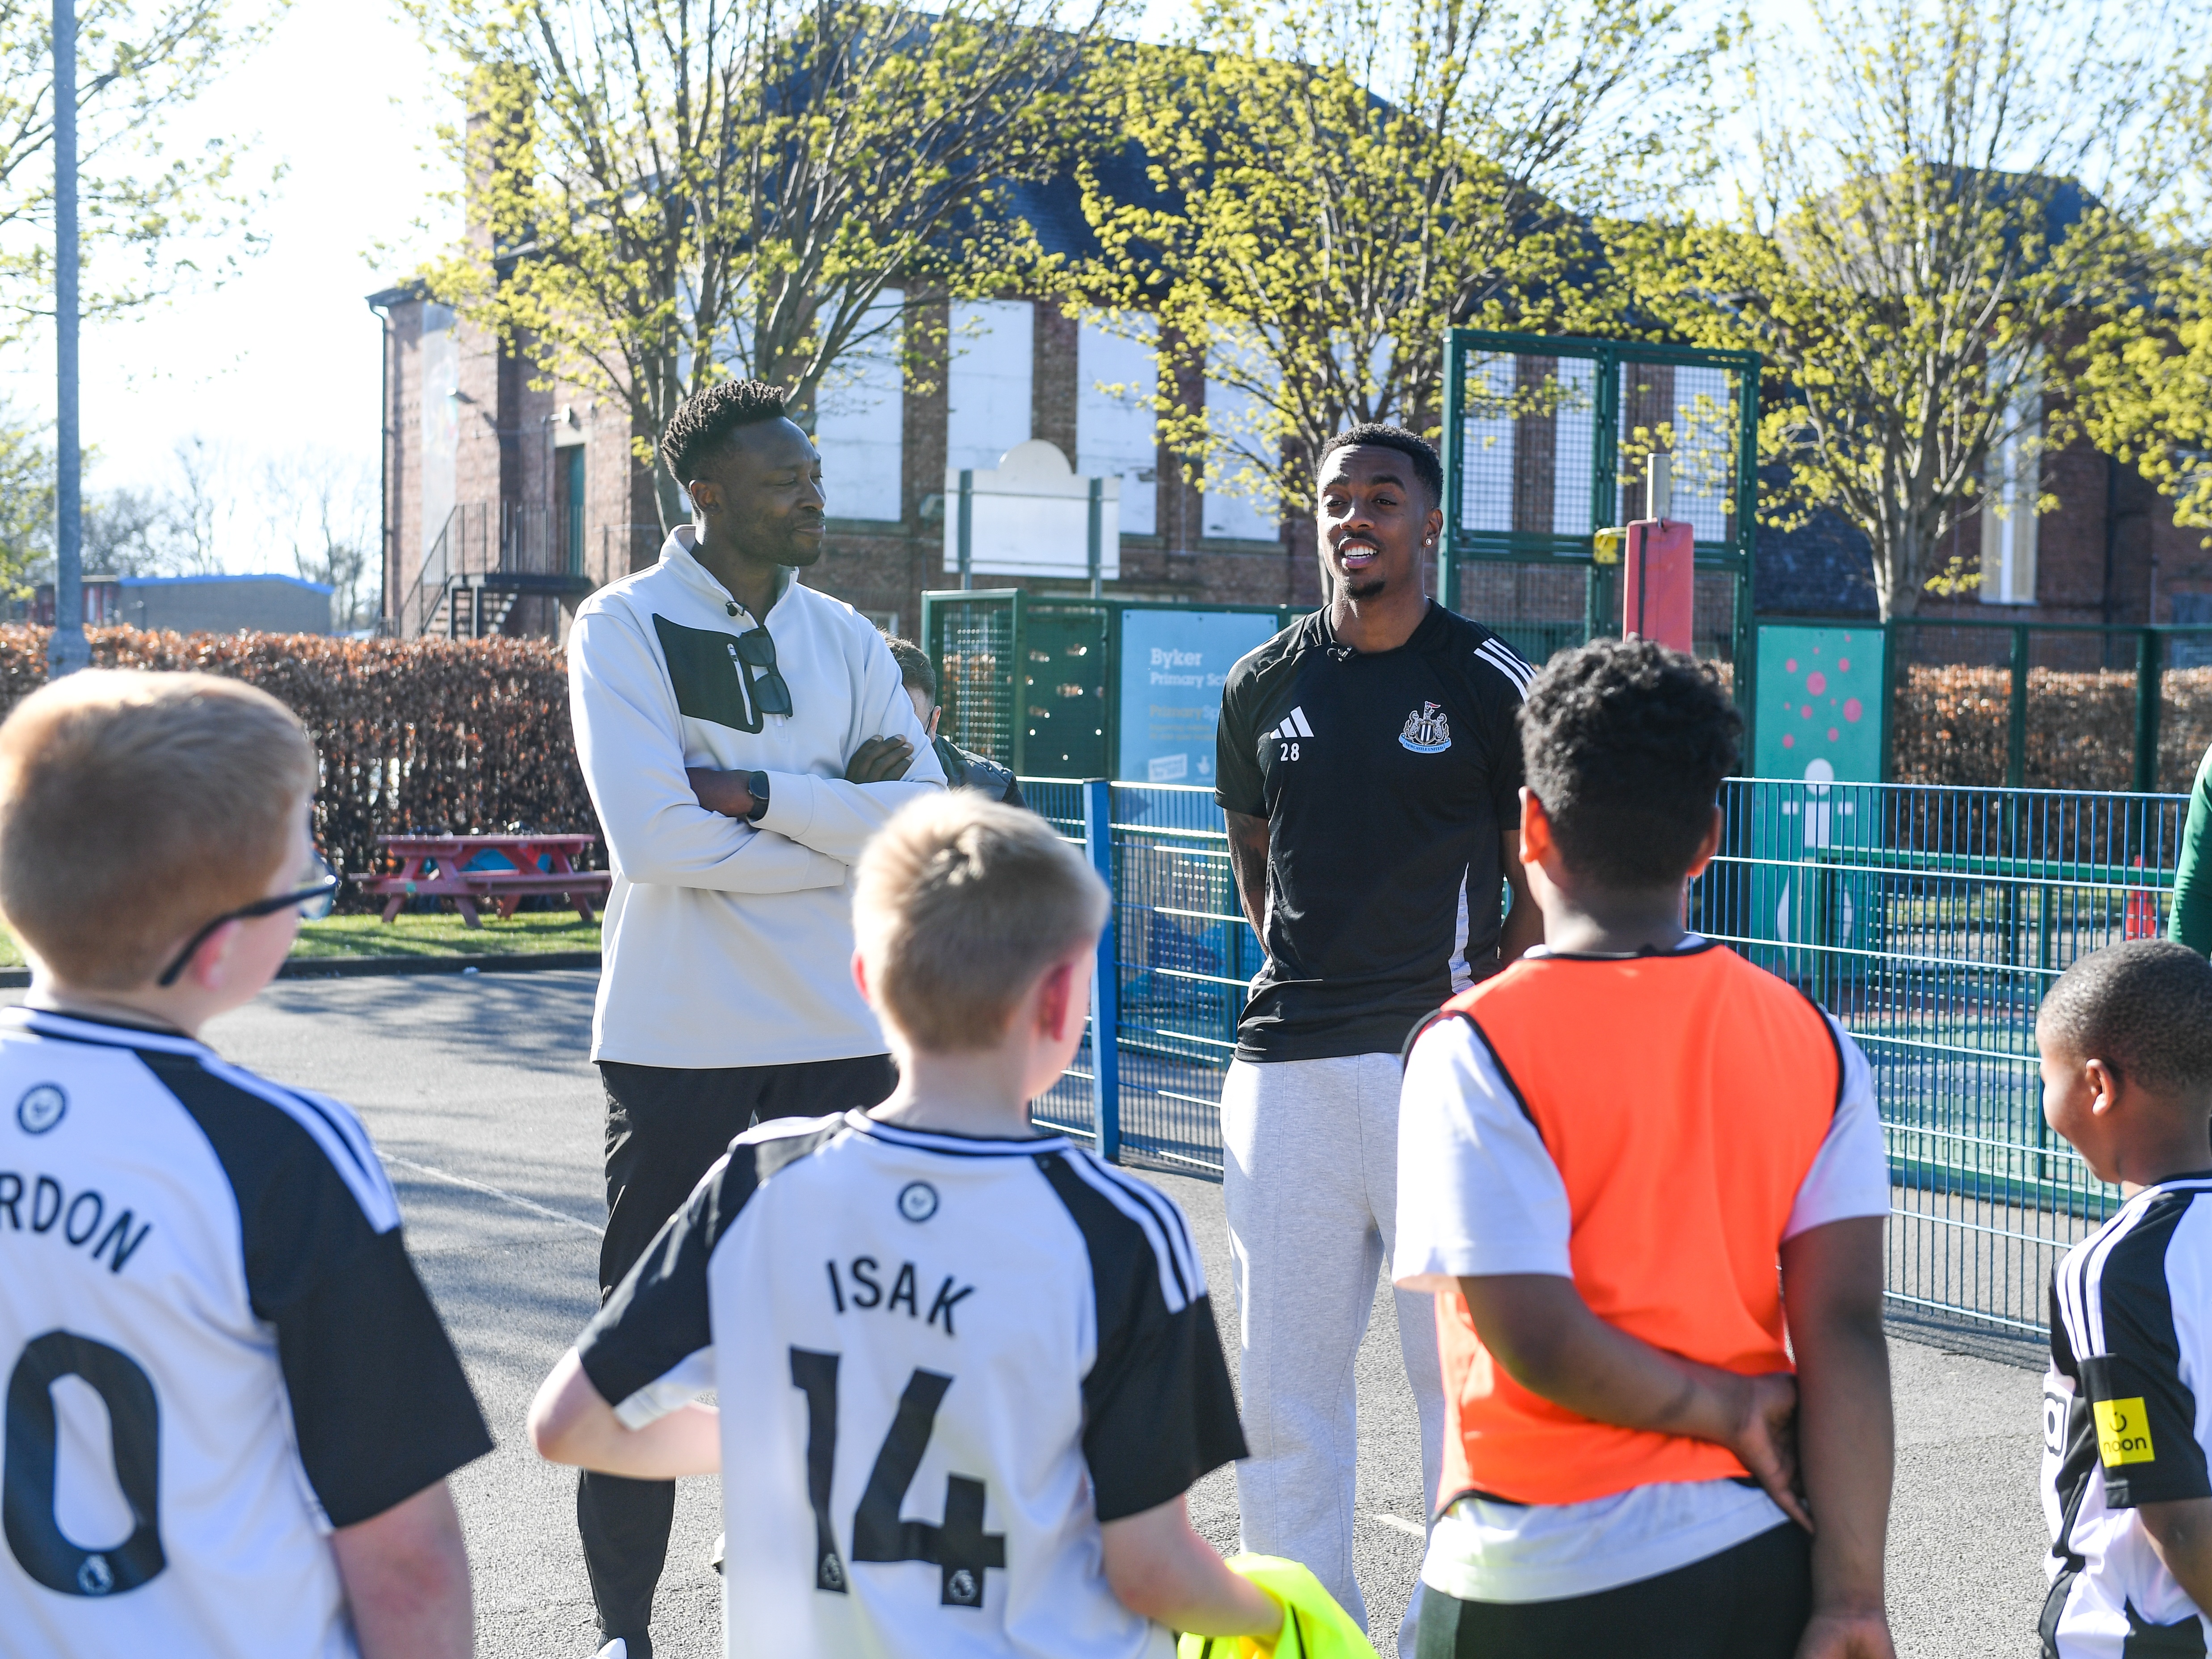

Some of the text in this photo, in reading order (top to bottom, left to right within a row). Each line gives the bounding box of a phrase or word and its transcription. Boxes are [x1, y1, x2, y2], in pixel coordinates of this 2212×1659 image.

[1151, 648, 1202, 669] Byker
[1151, 671, 1205, 689] Primary
[1280, 743, 1300, 762] 28
[1405, 742, 1427, 751] NEWCASTLE
[826, 1256, 977, 1336] ISAK
[2103, 1436, 2147, 1453] noon
[788, 1344, 1007, 1609] 14
